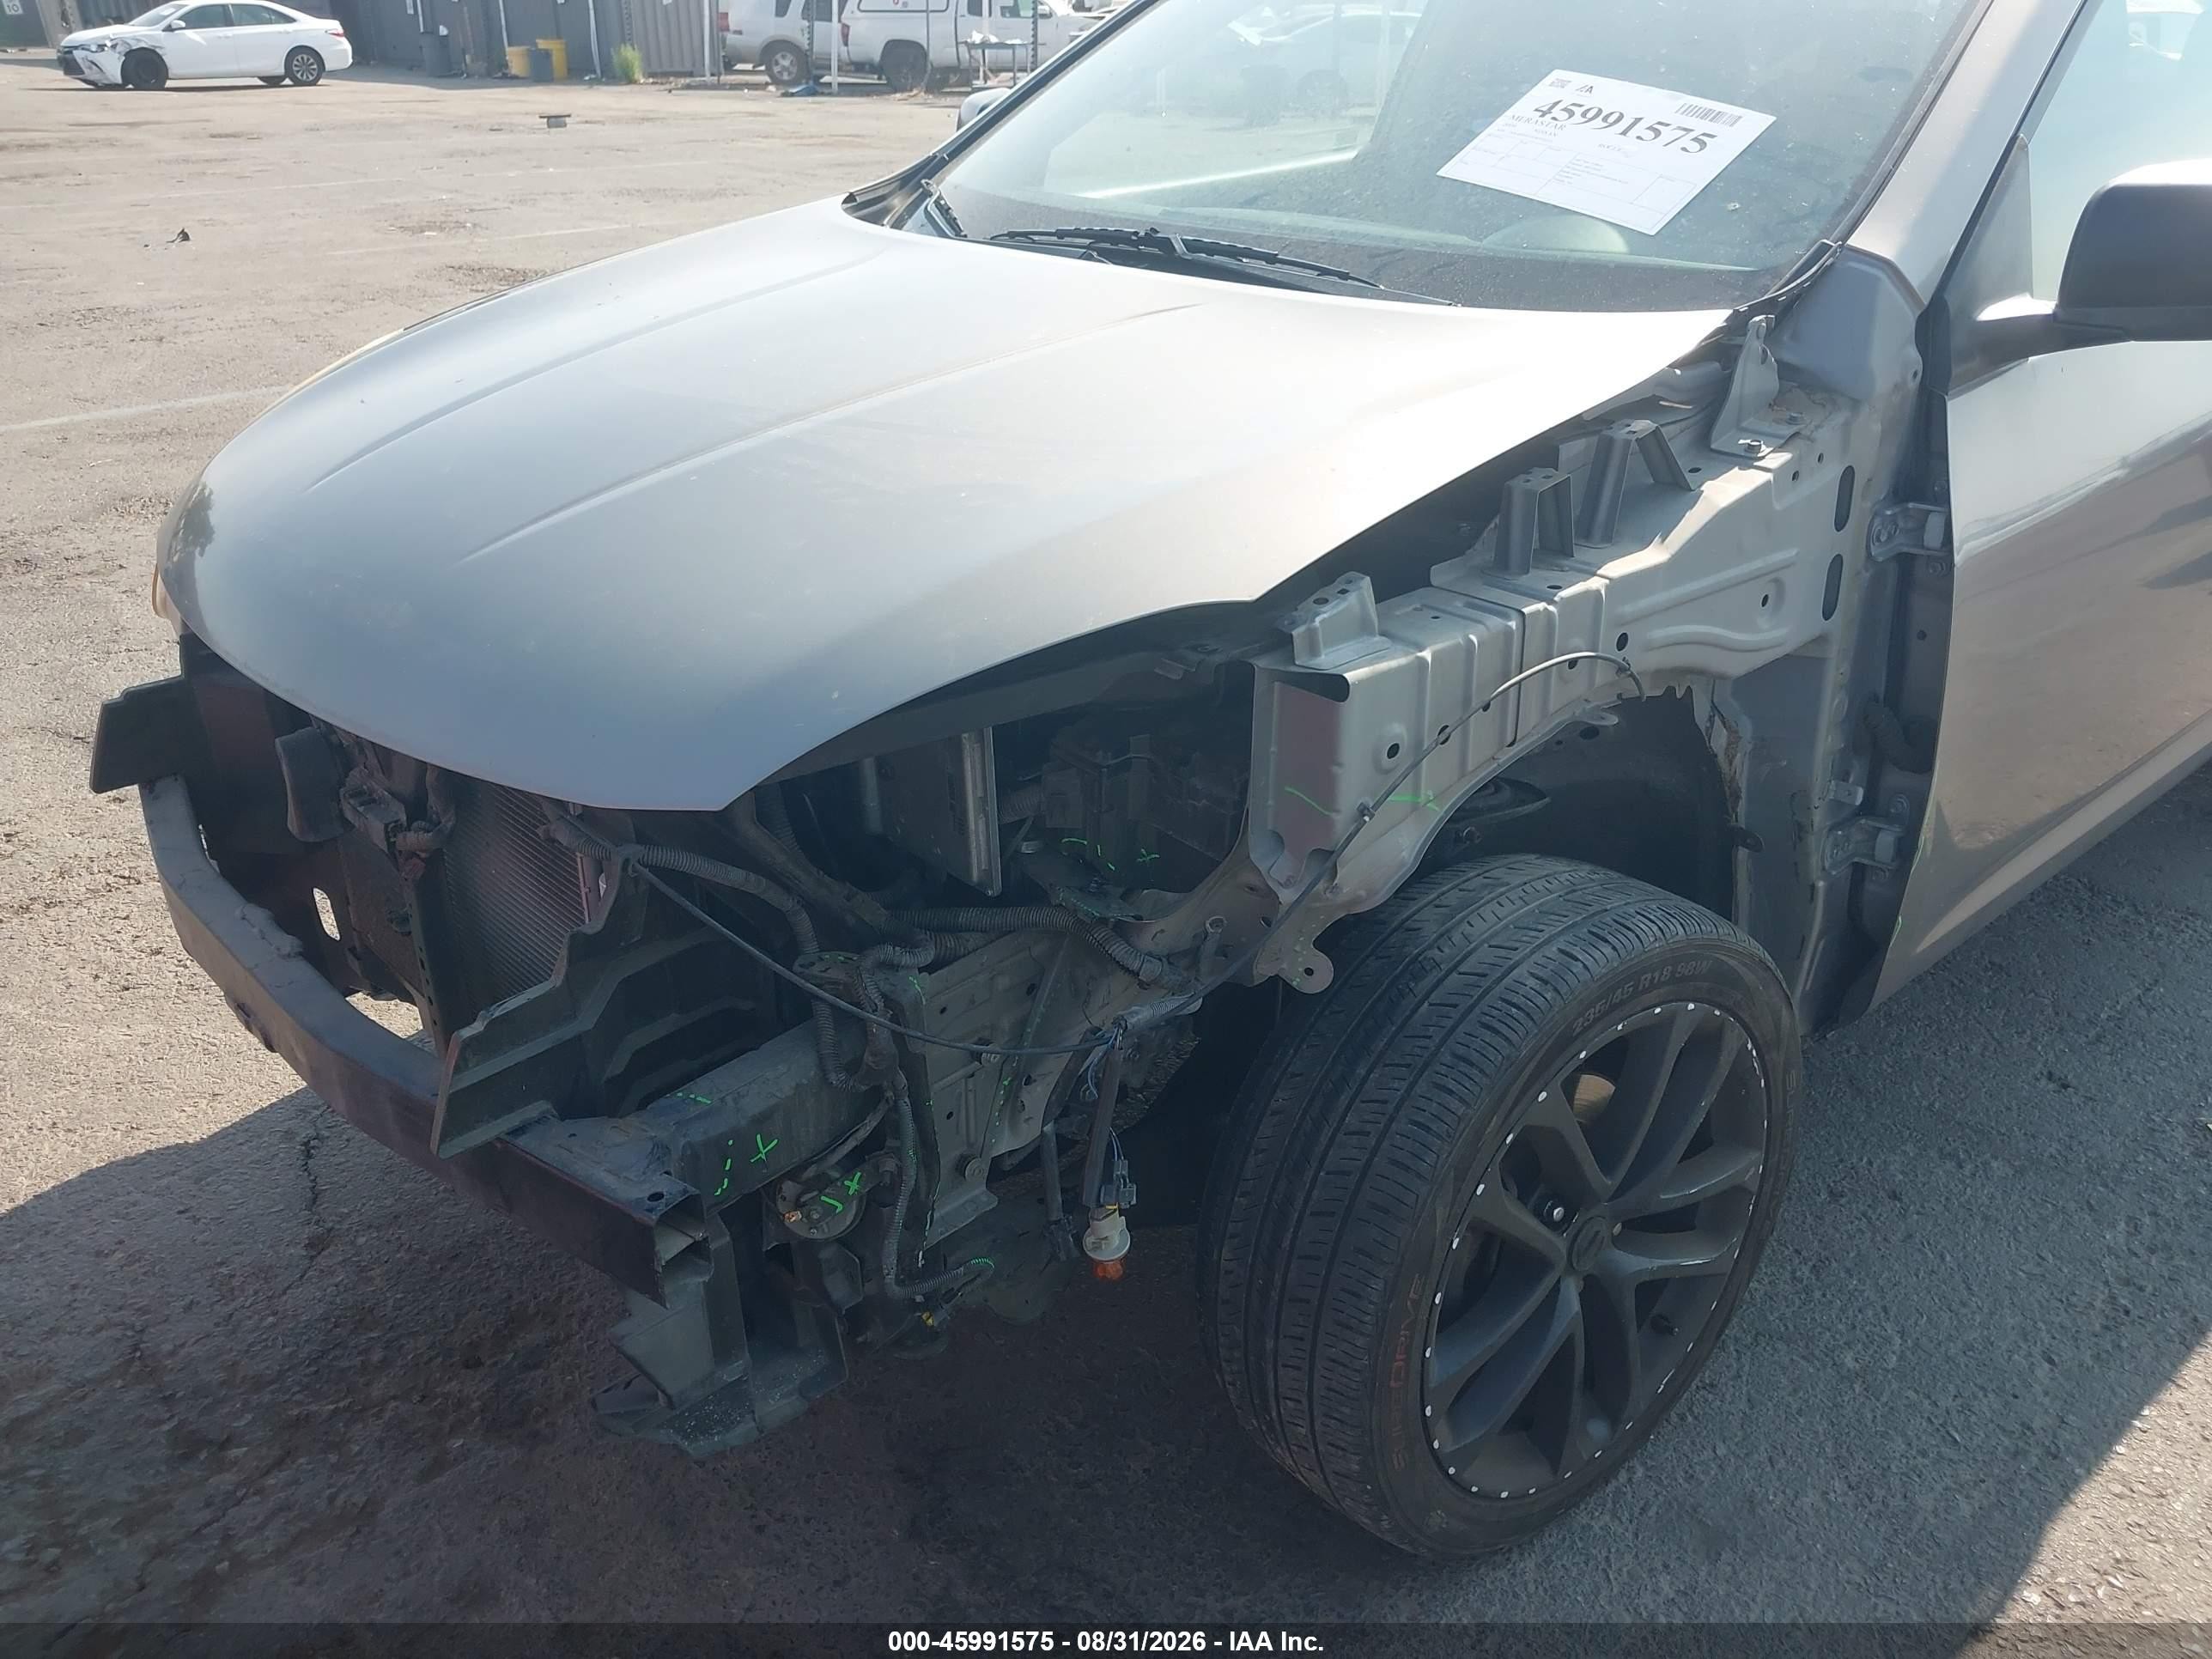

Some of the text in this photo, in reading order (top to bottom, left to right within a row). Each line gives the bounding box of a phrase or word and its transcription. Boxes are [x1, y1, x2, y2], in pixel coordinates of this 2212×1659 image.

[1508, 113, 1568, 131] MERASTAR
[1533, 99, 1717, 155] 45991575
[1573, 960, 1712, 1036] 235/45 R18 98W
